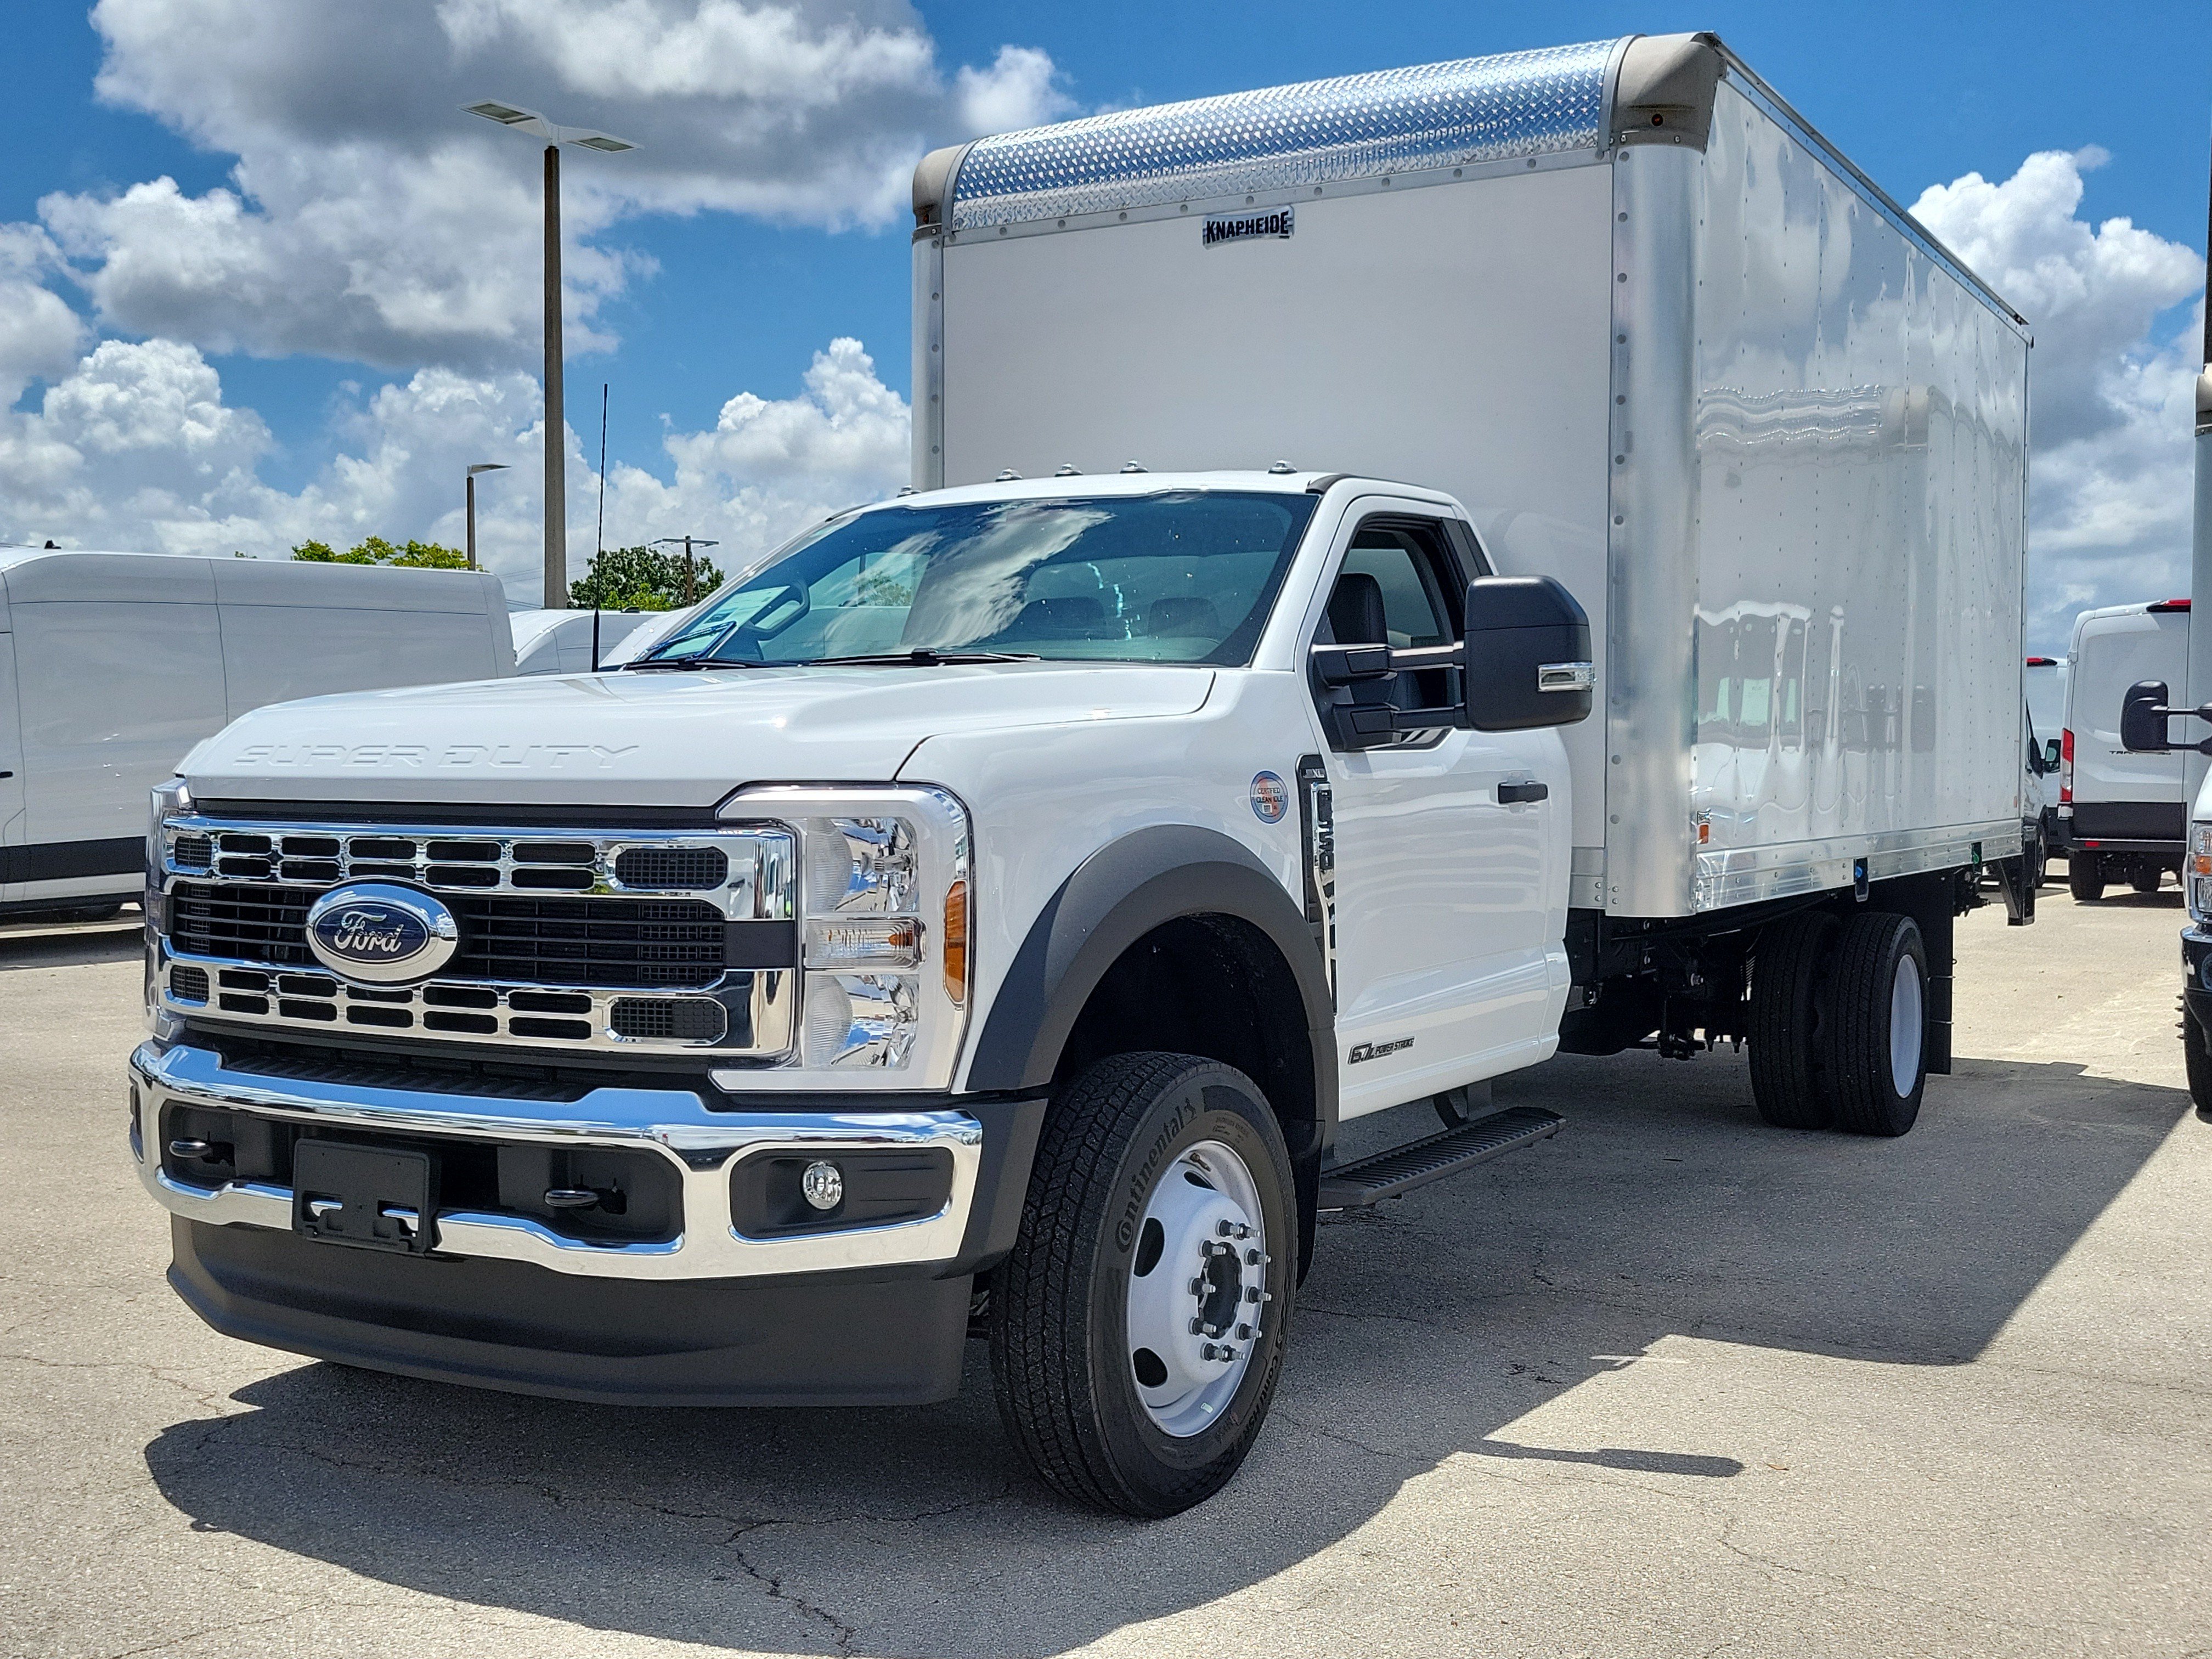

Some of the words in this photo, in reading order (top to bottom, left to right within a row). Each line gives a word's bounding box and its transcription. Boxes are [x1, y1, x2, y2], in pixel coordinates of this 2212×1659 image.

[1206, 211, 1289, 244] KNAPHEIDE
[233, 746, 430, 766] SUPER
[438, 746, 639, 768] DUTY
[1312, 768, 1325, 778] XL
[334, 911, 403, 952] Ford
[1115, 1105, 1184, 1253] Continental
